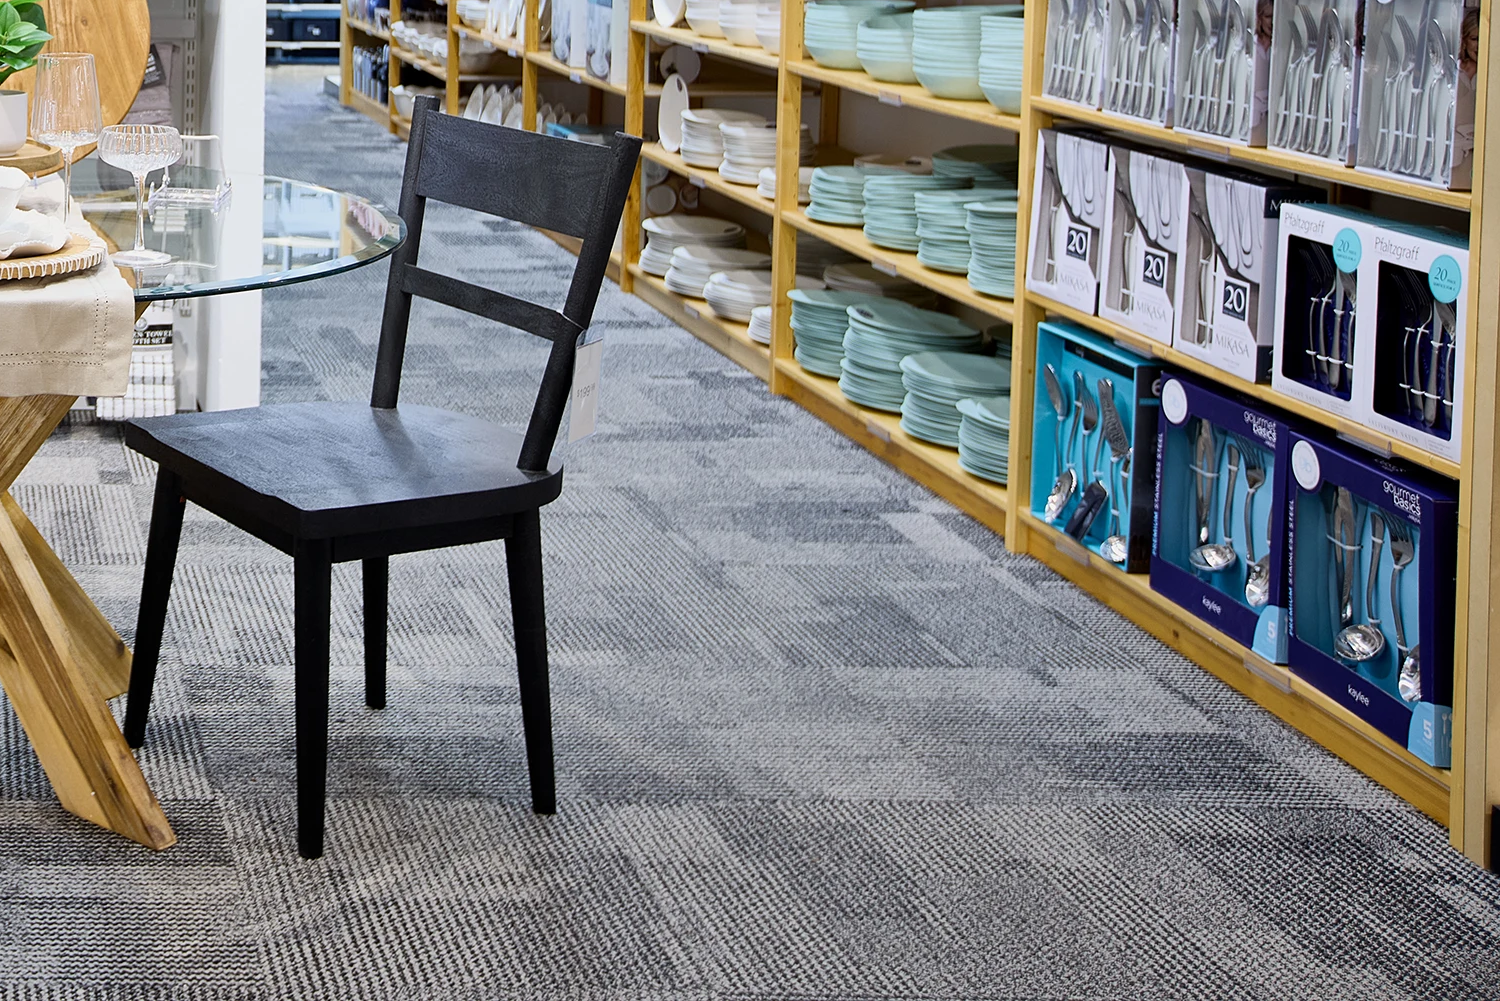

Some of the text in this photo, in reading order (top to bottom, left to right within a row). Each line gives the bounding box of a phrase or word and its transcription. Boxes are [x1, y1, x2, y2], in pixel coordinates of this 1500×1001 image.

[1284, 212, 1325, 234] Pfaltzgraff
[1068, 230, 1086, 252] 20
[1337, 239, 1349, 253] 20
[1374, 236, 1420, 261] Pfaltzgraff
[1144, 255, 1164, 279] 20
[1434, 267, 1447, 281] 20
[1059, 272, 1090, 294] MIKASA
[1223, 285, 1245, 313] 20
[1135, 300, 1168, 323] MIKASA
[1214, 333, 1249, 358] MIKASA
[1244, 411, 1276, 429] gourmet
[1252, 424, 1276, 443] basics
[1153, 461, 1161, 511] STAINLESS
[1383, 480, 1420, 505] gourmet
[1394, 494, 1421, 516] basics
[1202, 595, 1221, 615] kaylee
[1267, 620, 1276, 639] 5
[1348, 684, 1369, 707] kaylee
[1423, 719, 1433, 740] 5
